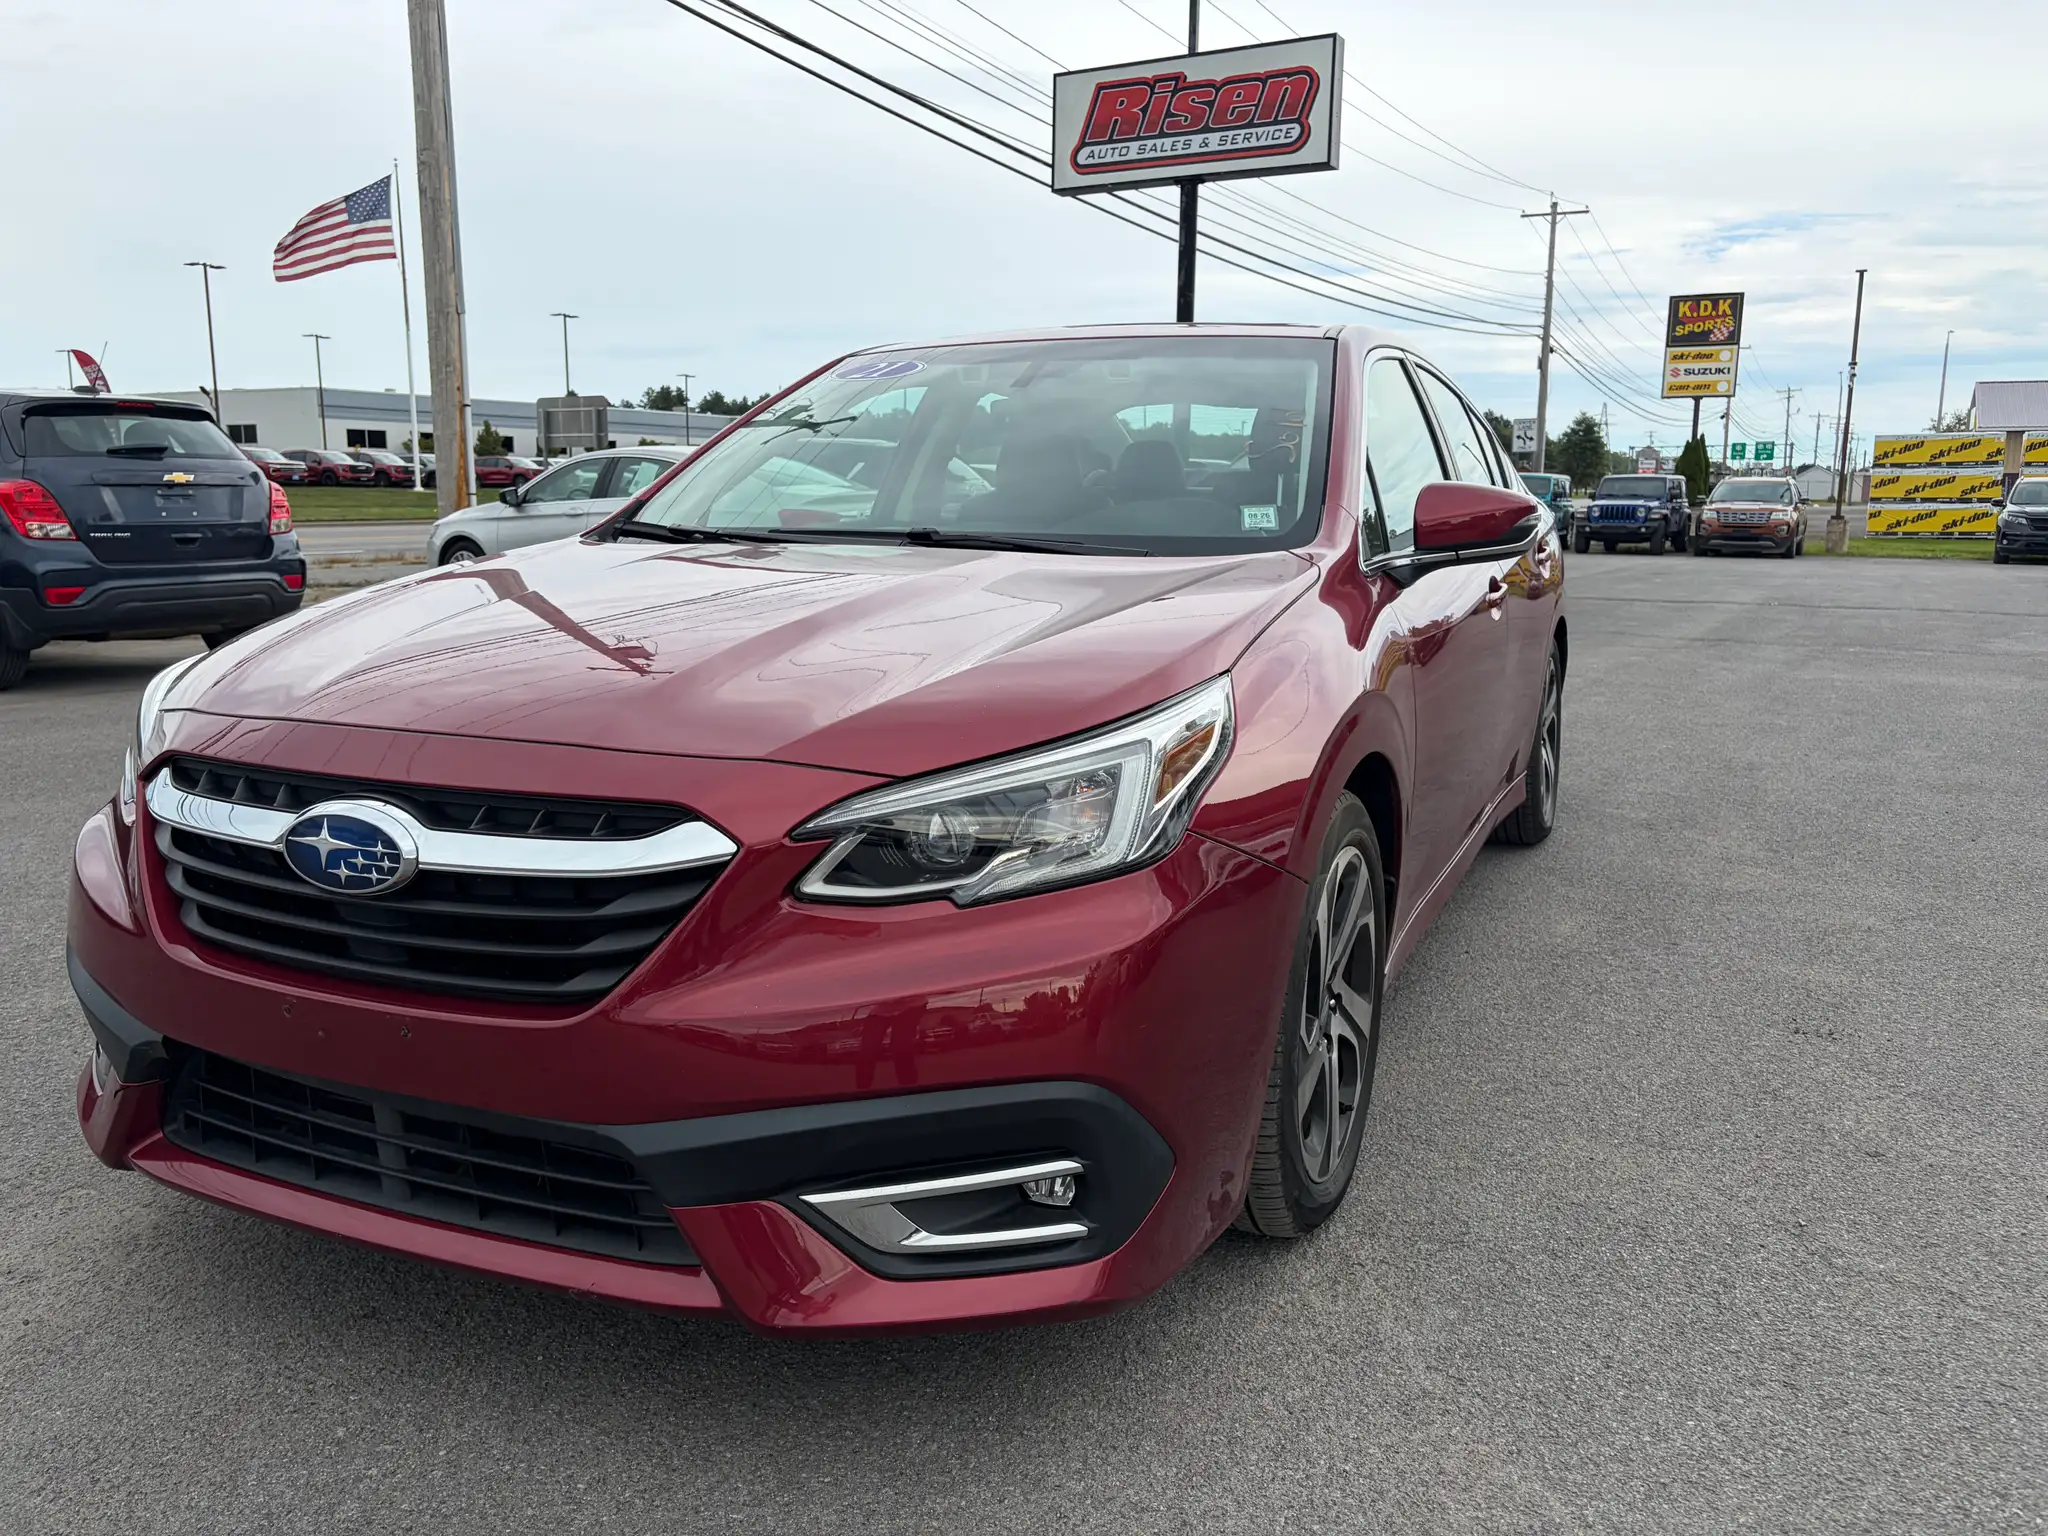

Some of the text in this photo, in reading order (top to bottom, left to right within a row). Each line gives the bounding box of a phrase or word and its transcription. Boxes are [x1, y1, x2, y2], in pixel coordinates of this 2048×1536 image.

[1085, 74, 1310, 142] Risen
[1084, 127, 1296, 161] AUTO SALES & SERVICE
[1679, 299, 1732, 318] K.D.K
[1675, 316, 1735, 336] SPORTS
[1683, 367, 1731, 376] SUZUKI
[1929, 438, 1982, 461] ski-doo
[1904, 476, 1957, 497] ski-doo
[1885, 510, 1938, 531] ski-doo
